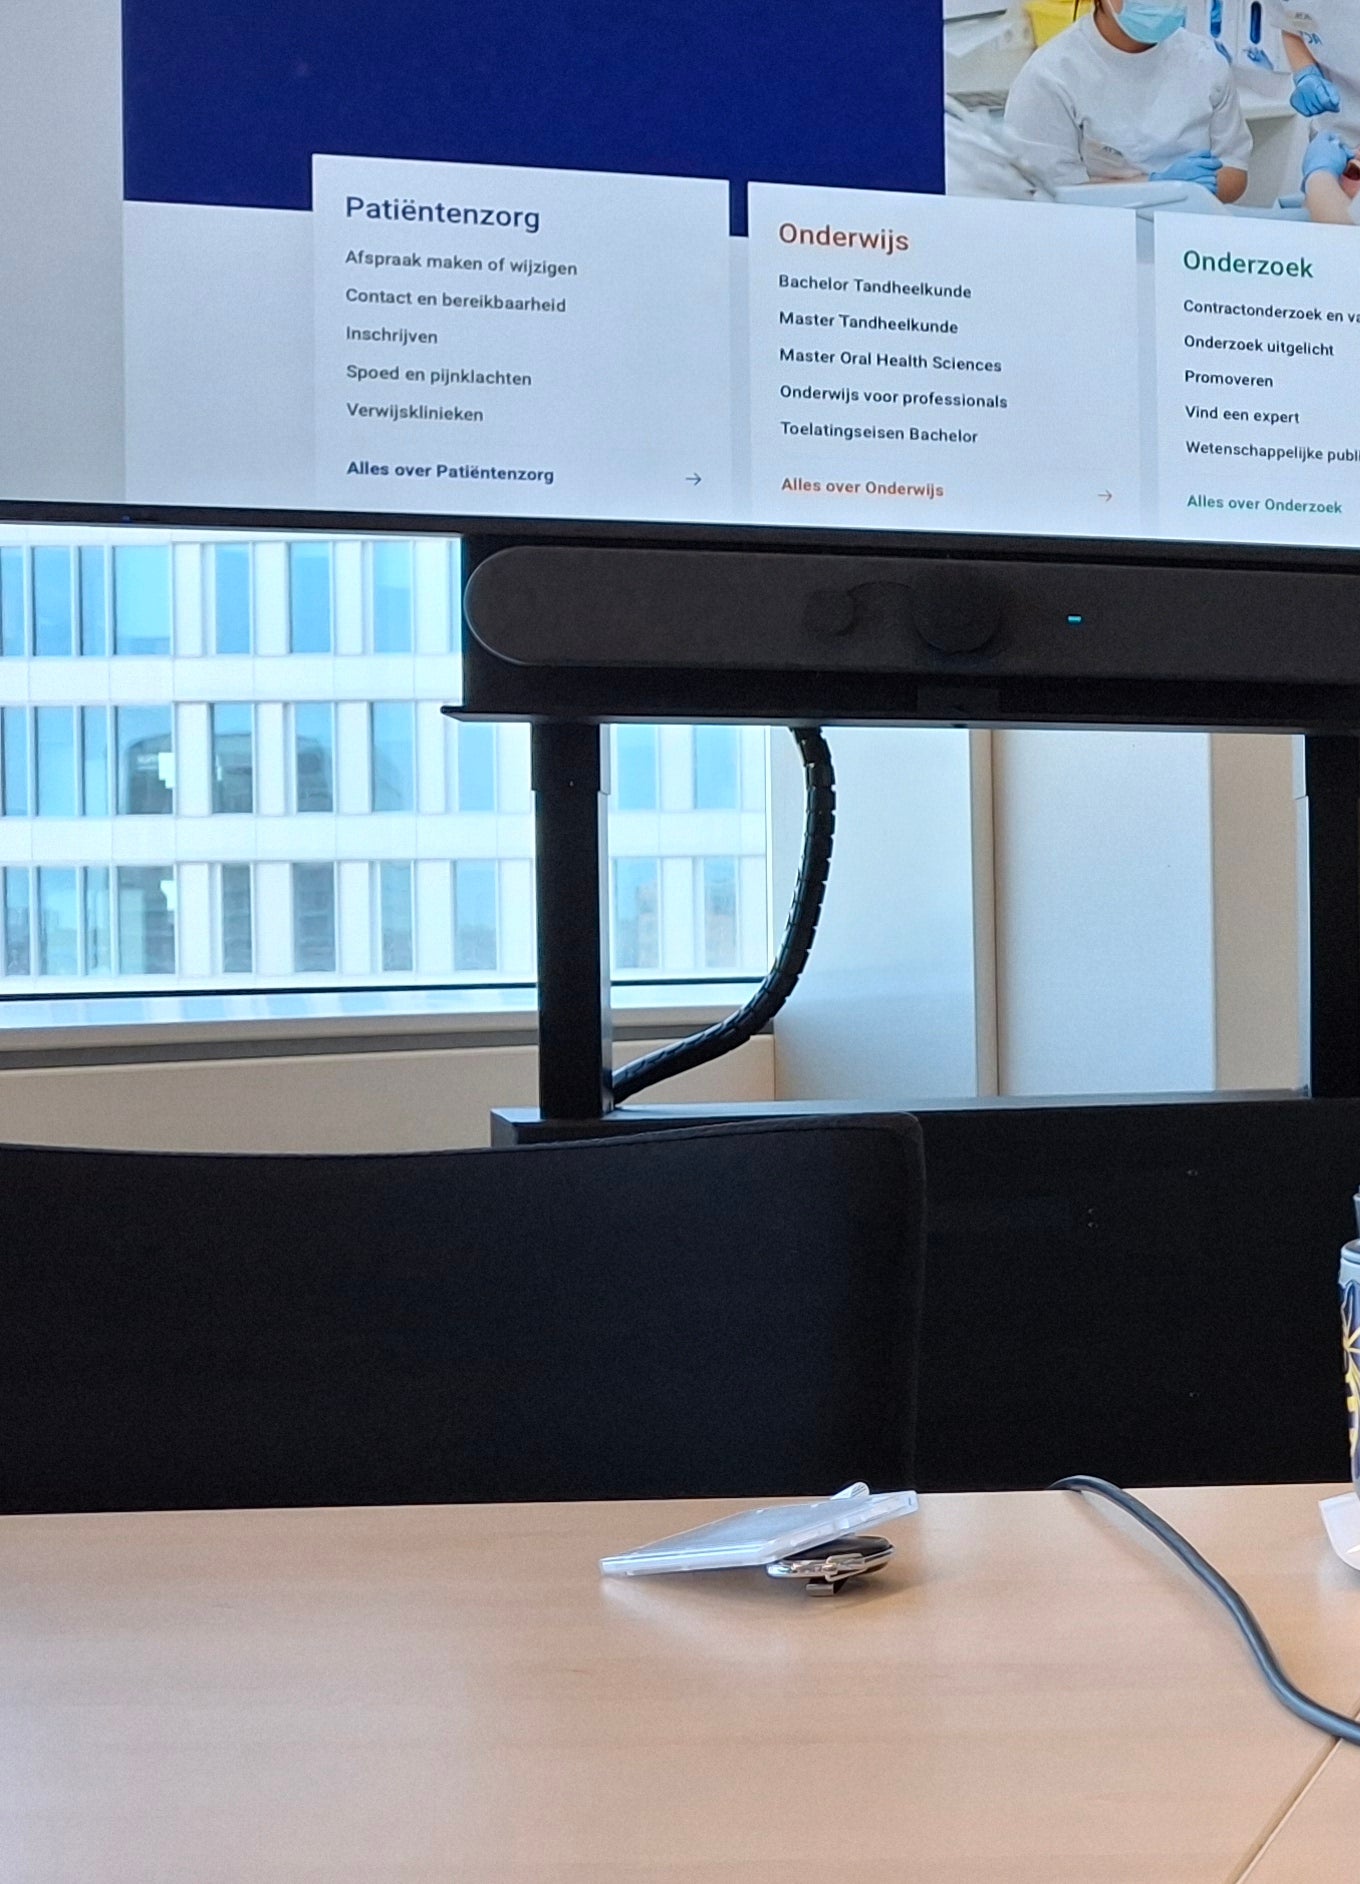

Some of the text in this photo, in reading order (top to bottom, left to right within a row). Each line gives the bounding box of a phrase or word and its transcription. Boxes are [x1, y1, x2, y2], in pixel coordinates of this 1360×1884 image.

[346, 196, 540, 234] Patiëntenzorg
[779, 222, 909, 256] Onderwijs
[344, 249, 578, 279] Afspraak maken of wijzigen
[1183, 249, 1314, 279] Onderzoek
[778, 274, 972, 299] Bachelor Tandheelkunde
[345, 288, 566, 313] Contact en bereikbaarheid
[1183, 299, 1323, 321] Contractonderzoek
[1326, 311, 1344, 323] en
[779, 310, 959, 334] Master Tandheelkunde
[346, 325, 438, 347] Inschrijven
[1184, 334, 1334, 357] Onderzoek uitgelicht
[779, 347, 1002, 373] Master Oral Health Sciences
[346, 364, 532, 387] Spoed en pijnklachten
[1184, 369, 1274, 388] Promoveren
[779, 384, 1008, 409] Onderwijs voor professionals
[346, 402, 484, 422] Verwijsklinieken
[1185, 405, 1300, 426] Vind een expert
[780, 421, 978, 443] Toelatingseisen Bachelor
[1185, 440, 1324, 463] Wetenschappelijke
[346, 460, 554, 485] Alles over Patiëntenzorg
[781, 477, 944, 500] Alles over Onderwijs
[1186, 494, 1342, 514] Alles over Onderzoek
